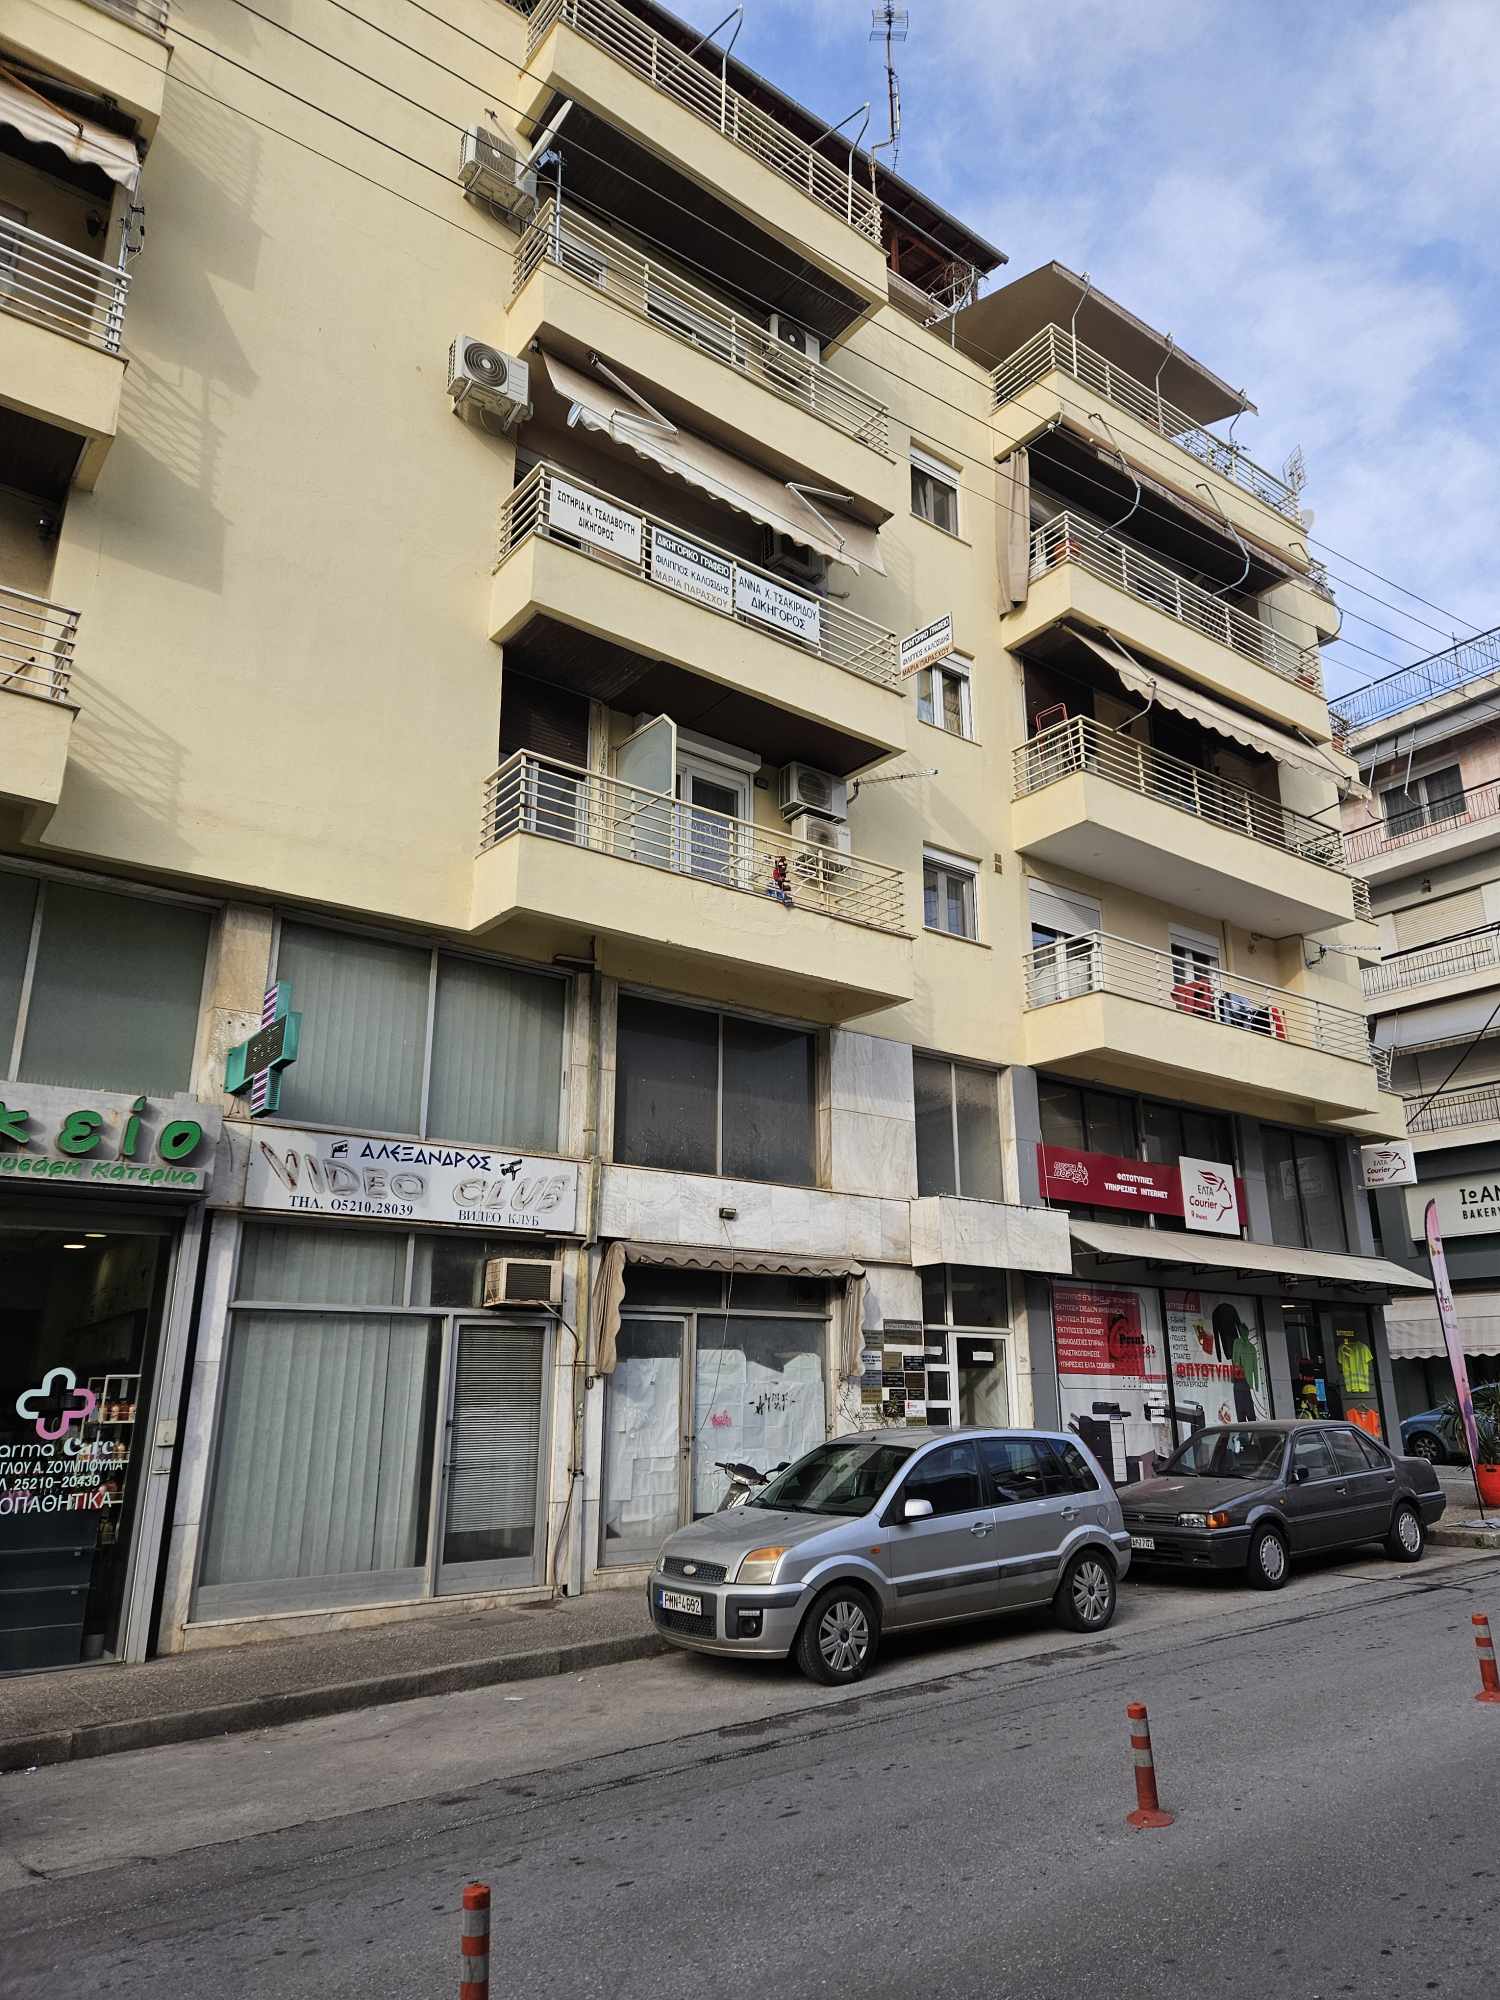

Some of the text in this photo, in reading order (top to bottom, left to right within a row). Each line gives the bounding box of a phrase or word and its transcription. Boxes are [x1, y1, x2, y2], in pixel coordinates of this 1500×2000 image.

[557, 490, 585, 512] ΣΩΤΗΡΙΑ
[578, 517, 615, 541] ΔΙΚΗΓΟΡΟΣ
[657, 535, 729, 577] ΔΙΚΗΓΟΡΙΚΟ ΓΡΑΦΕΙΟ
[655, 569, 682, 588] ΜΑΡΙΑ
[738, 575, 761, 594] ΑΝΝΑ
[751, 597, 806, 630] ΔΙΚΗΓΟΡΟΣ
[360, 1141, 492, 1172] ΑΛΕΞΑΝΔΡΟΣ
[1367, 1166, 1392, 1175] Courier
[1197, 1184, 1215, 1197] ΕΛΤΑ
[289, 1195, 324, 1209] ΤΗΛ.
[1189, 1195, 1218, 1210] Courier
[458, 1208, 540, 1226] ВИДЕО КЛУБ
[1462, 1206, 1500, 1220] BAKER
[63, 1437, 115, 1457] Care
[0, 1491, 112, 1516] ΟΠΑΘΗΤΙΚΑ
